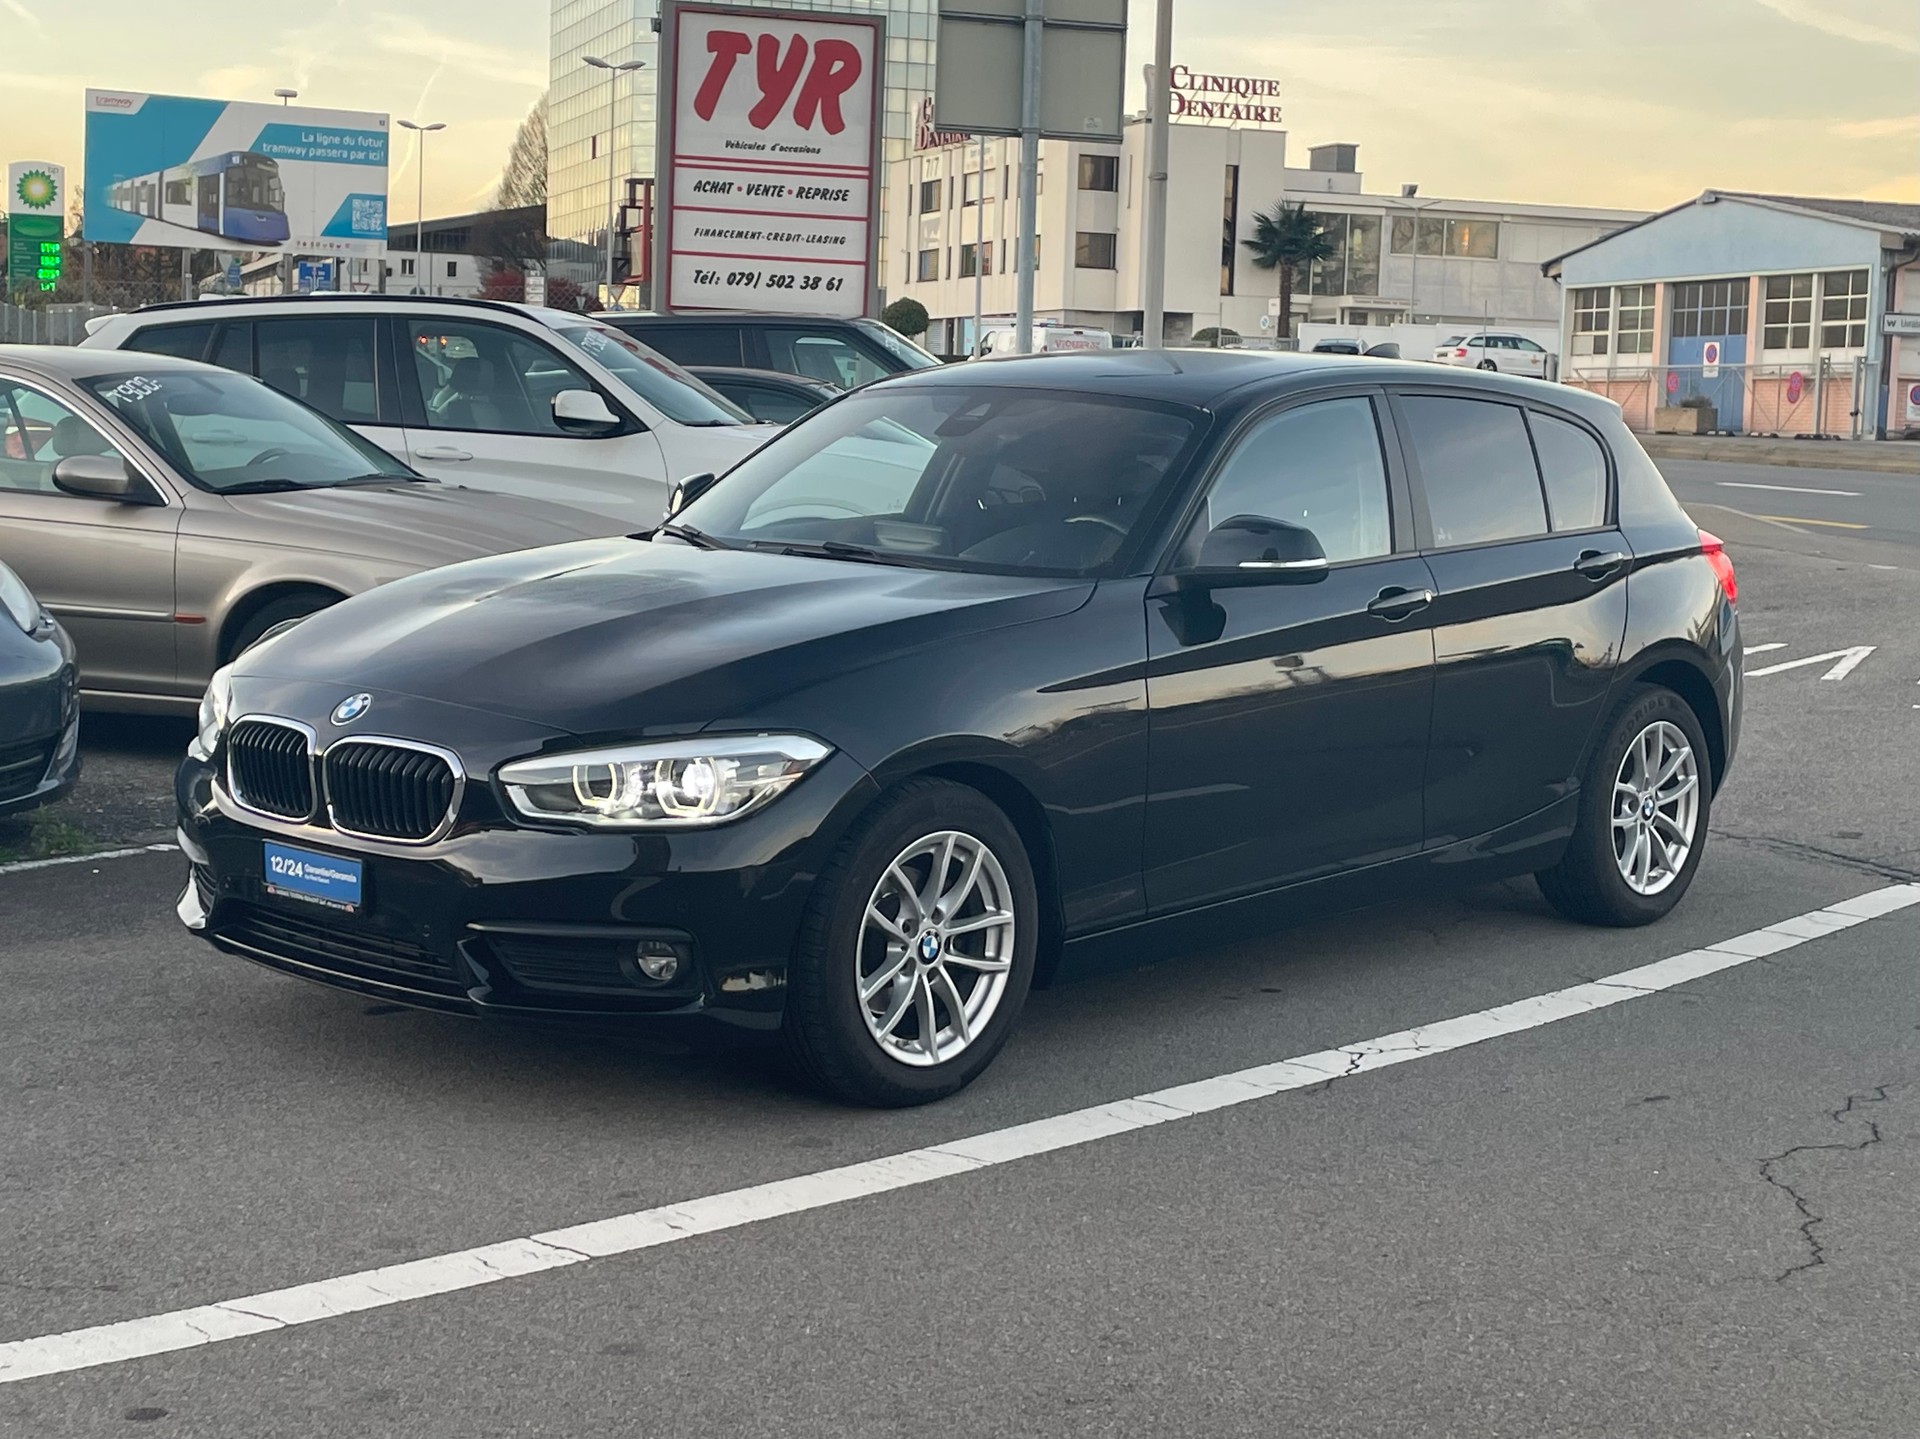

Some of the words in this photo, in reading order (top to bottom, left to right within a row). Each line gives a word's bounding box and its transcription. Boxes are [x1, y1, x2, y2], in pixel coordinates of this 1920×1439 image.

[693, 30, 862, 135] TYR
[1170, 65, 1280, 98] CLINIQUE
[1169, 91, 1282, 123] DENTAIRE
[301, 132, 314, 143] La
[316, 133, 341, 146] ligne
[343, 135, 355, 146] du
[357, 136, 384, 148] futur
[262, 143, 307, 156] tramway
[309, 147, 348, 158] passera
[350, 150, 366, 160] par
[693, 180, 734, 194] ACHAT
[746, 183, 785, 198] VENTE
[796, 186, 850, 202] REPRISE
[805, 234, 846, 246] LEASING
[766, 274, 795, 289] 502
[800, 275, 822, 291] 38
[826, 277, 844, 292] 61
[270, 855, 304, 878] 12/24
